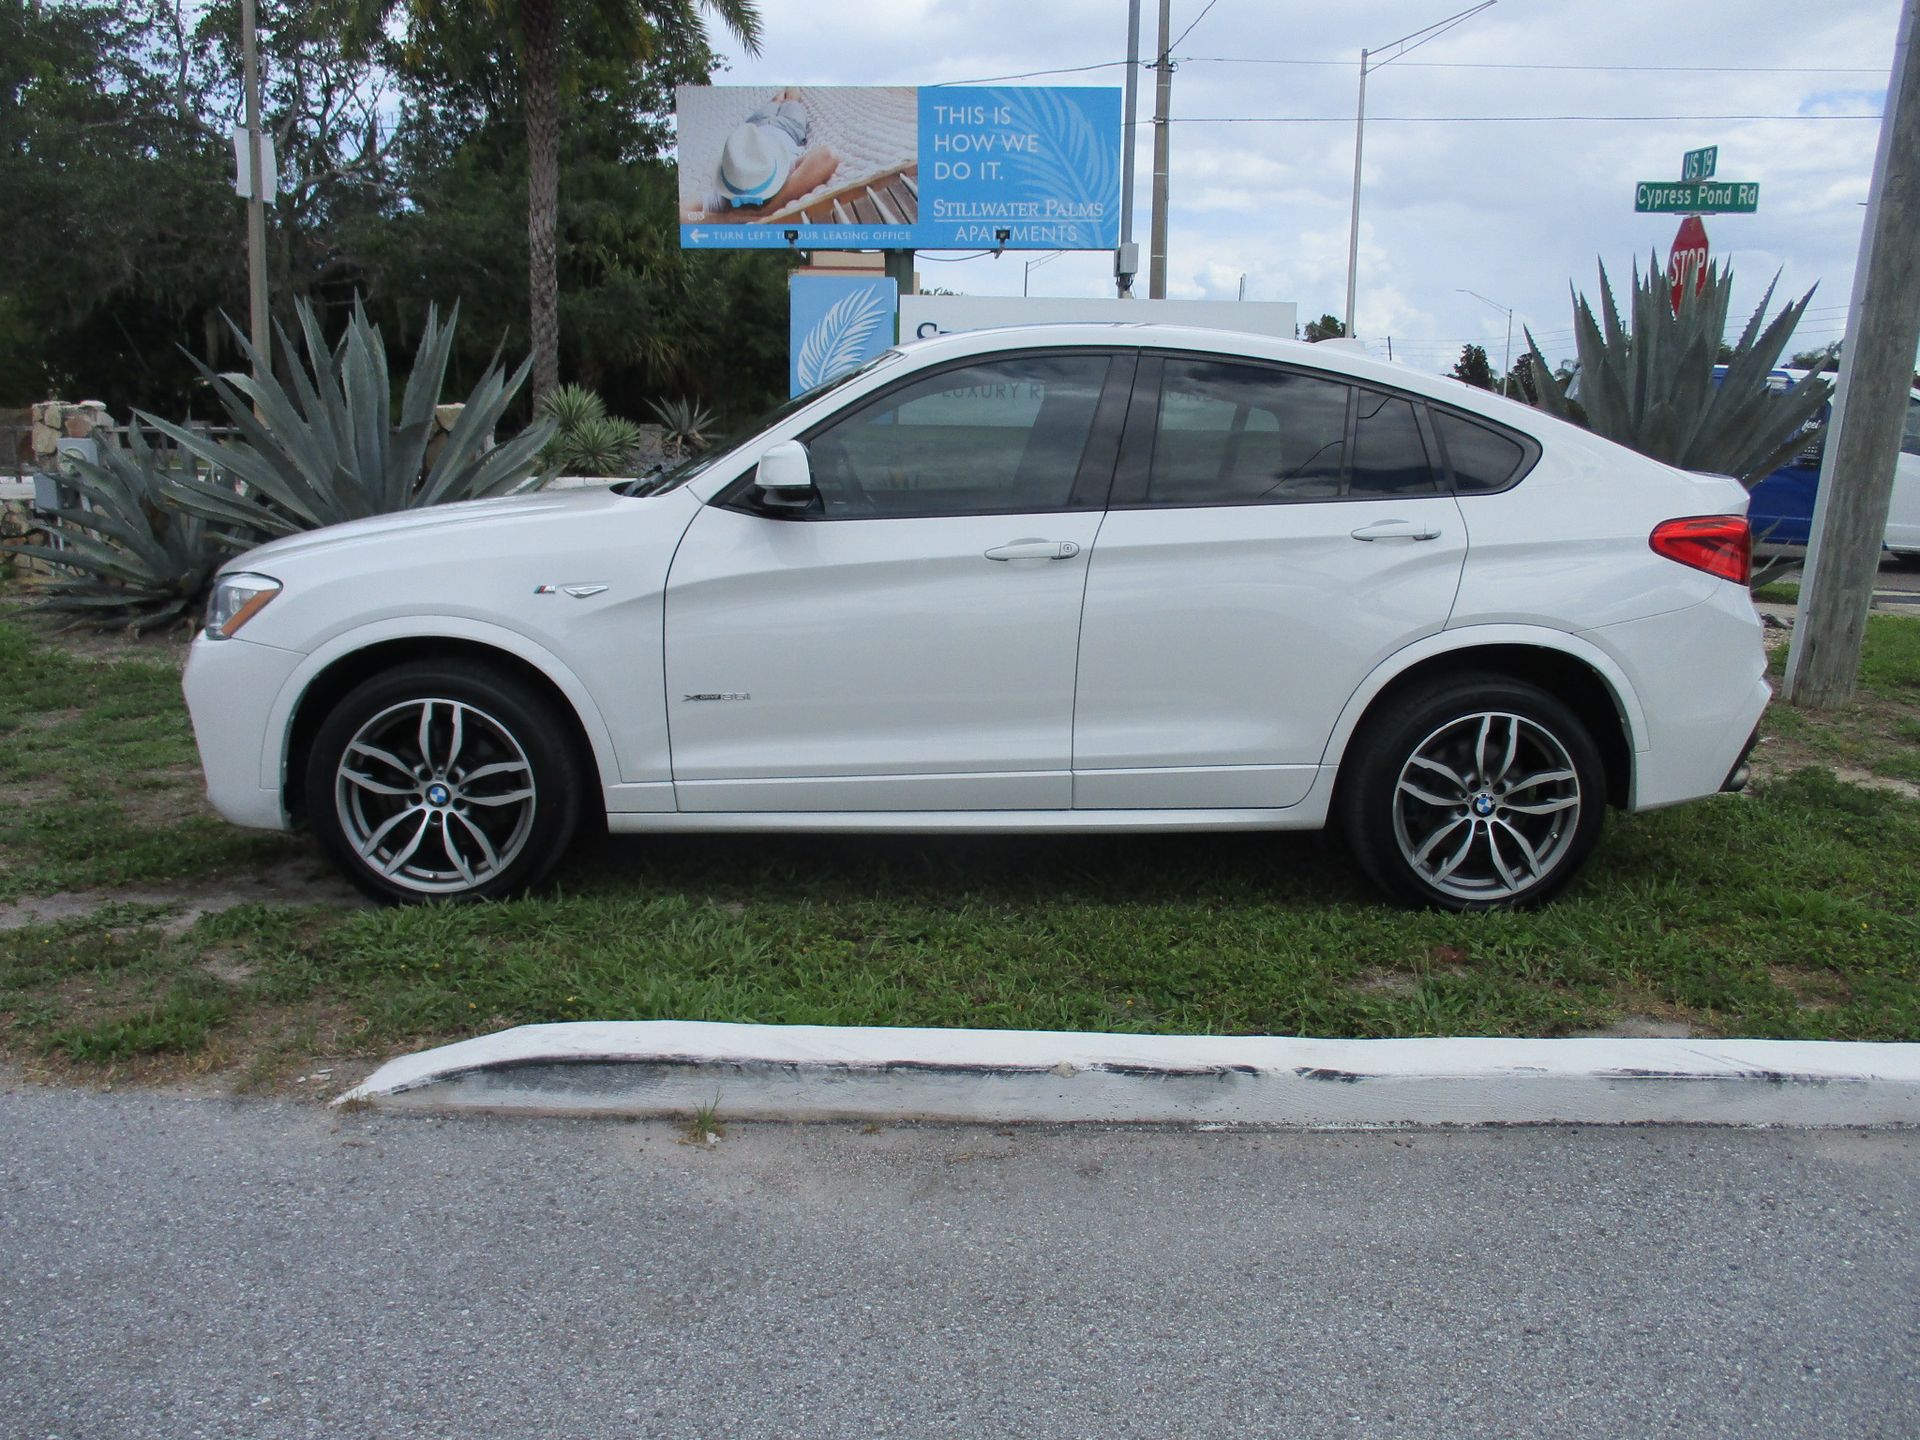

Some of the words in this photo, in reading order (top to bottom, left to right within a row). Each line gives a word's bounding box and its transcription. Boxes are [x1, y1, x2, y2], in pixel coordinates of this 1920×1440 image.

[933, 105, 984, 125] THIS
[994, 105, 1011, 125] IS
[934, 133, 996, 153] HOW
[1001, 133, 1039, 153] WE
[934, 161, 971, 180] DO
[981, 161, 1004, 180] IT.
[1684, 152, 1699, 179] US
[1703, 149, 1713, 177] 19
[1637, 185, 1691, 209] Cypress
[1697, 185, 1732, 205] Pond
[1738, 185, 1757, 205] Rd
[713, 231, 743, 241] TURN
[747, 231, 772, 241] LEFT
[823, 231, 869, 241] LEASING
[873, 231, 912, 241] OFFICE
